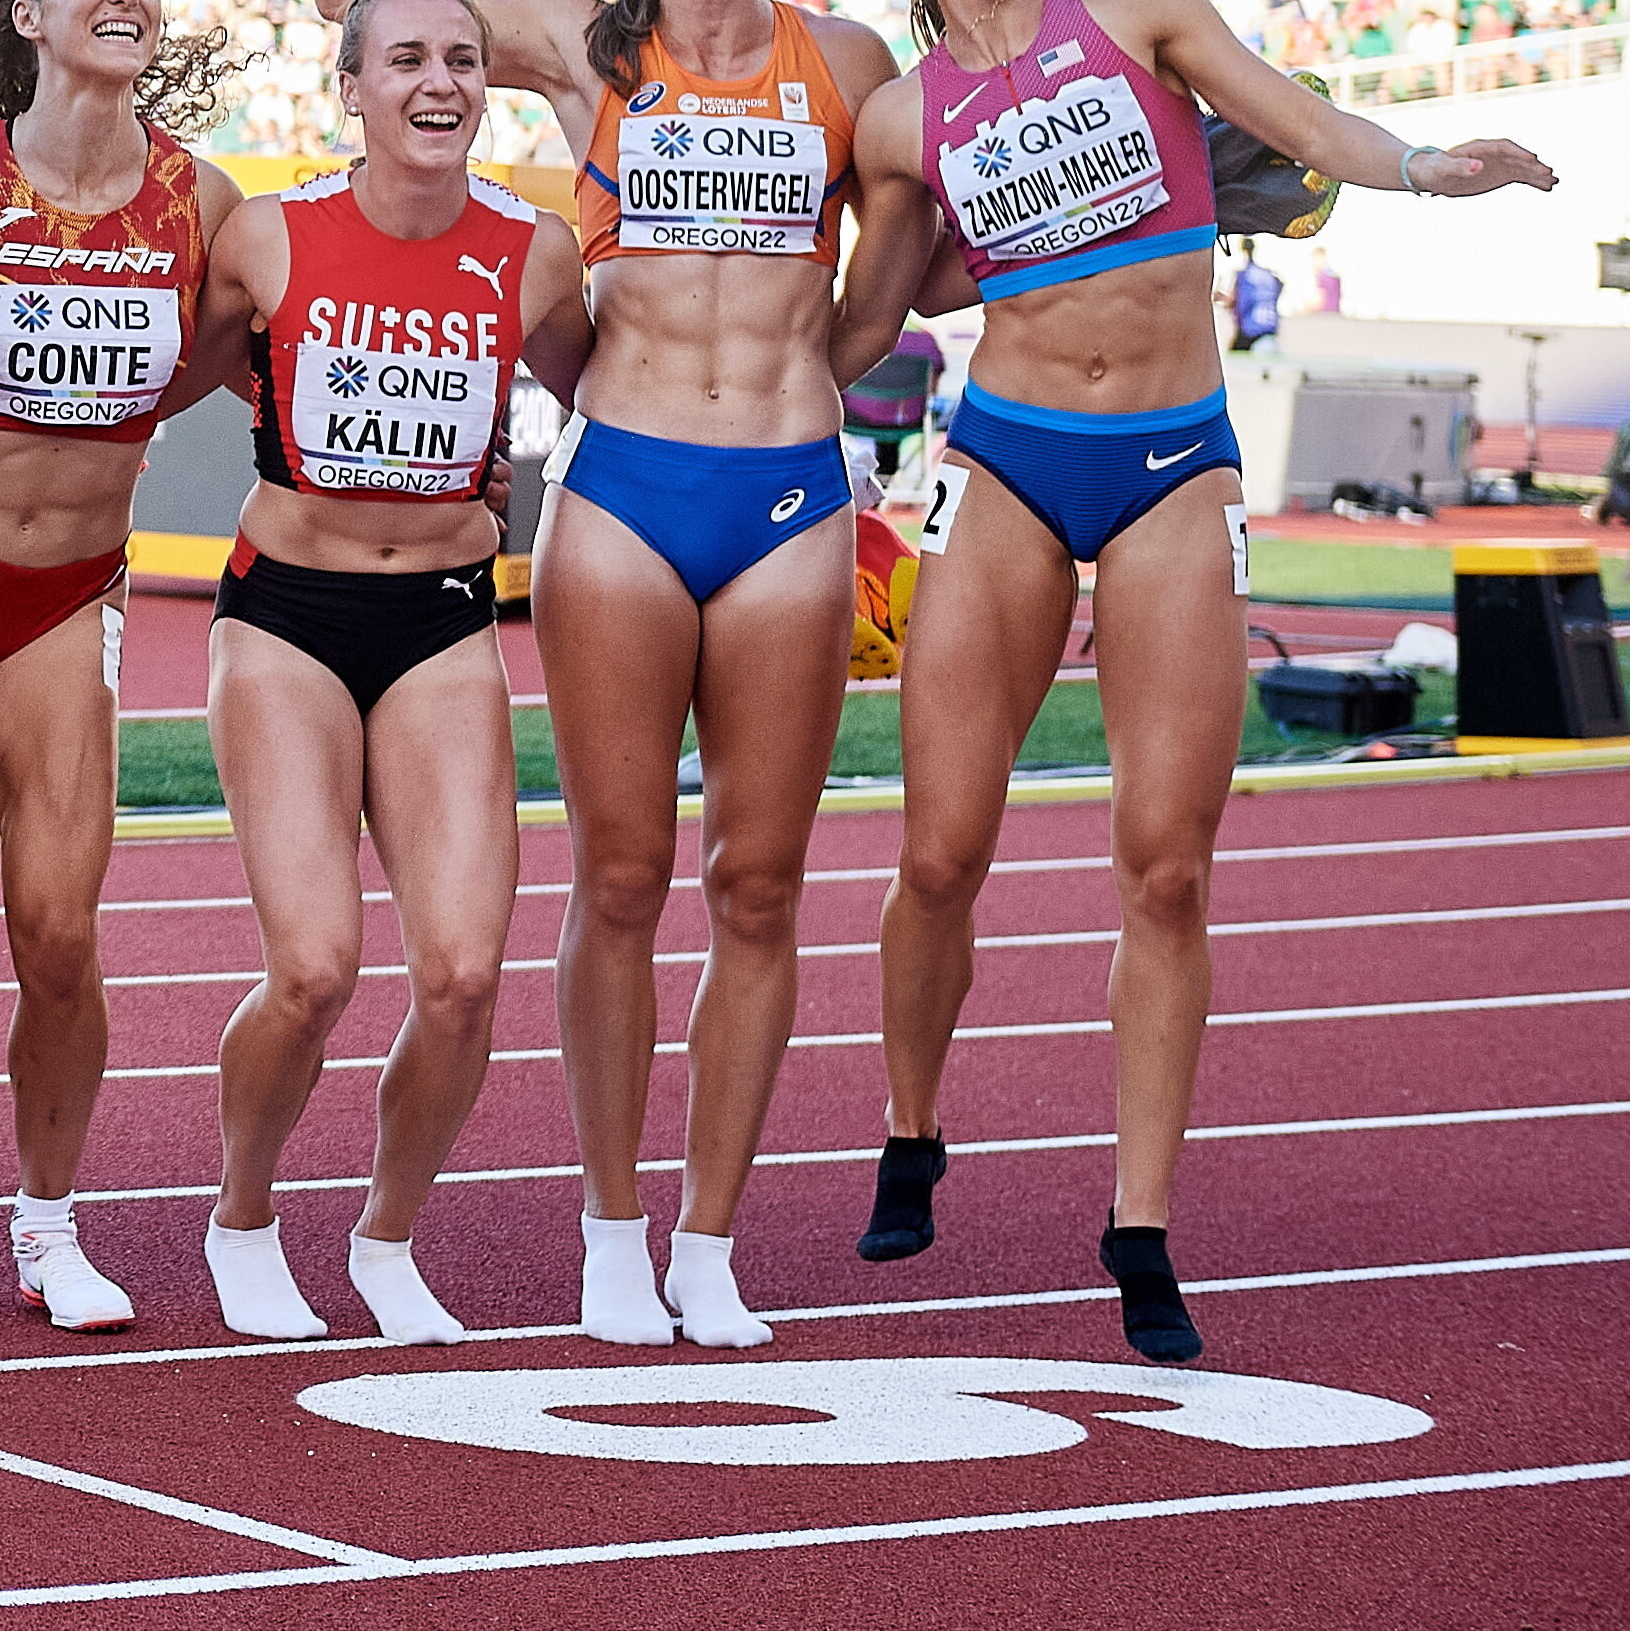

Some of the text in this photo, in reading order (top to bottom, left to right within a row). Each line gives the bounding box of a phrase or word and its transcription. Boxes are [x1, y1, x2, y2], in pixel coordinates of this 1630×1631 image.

[702, 127, 796, 158] QNB
[1019, 98, 1111, 154] QNB
[627, 169, 813, 214] OOSTERWEGEL
[962, 130, 1153, 239] ZAMZOW-MAHLER
[653, 227, 786, 249] OREGON22
[1014, 195, 1143, 256] OREGON22
[61, 297, 150, 330] QNB
[7, 342, 152, 386] CONTE
[378, 365, 469, 402] QNB
[9, 396, 139, 421] OREGON22
[325, 409, 457, 460] KÄLIN
[317, 464, 452, 492] OREGON22
